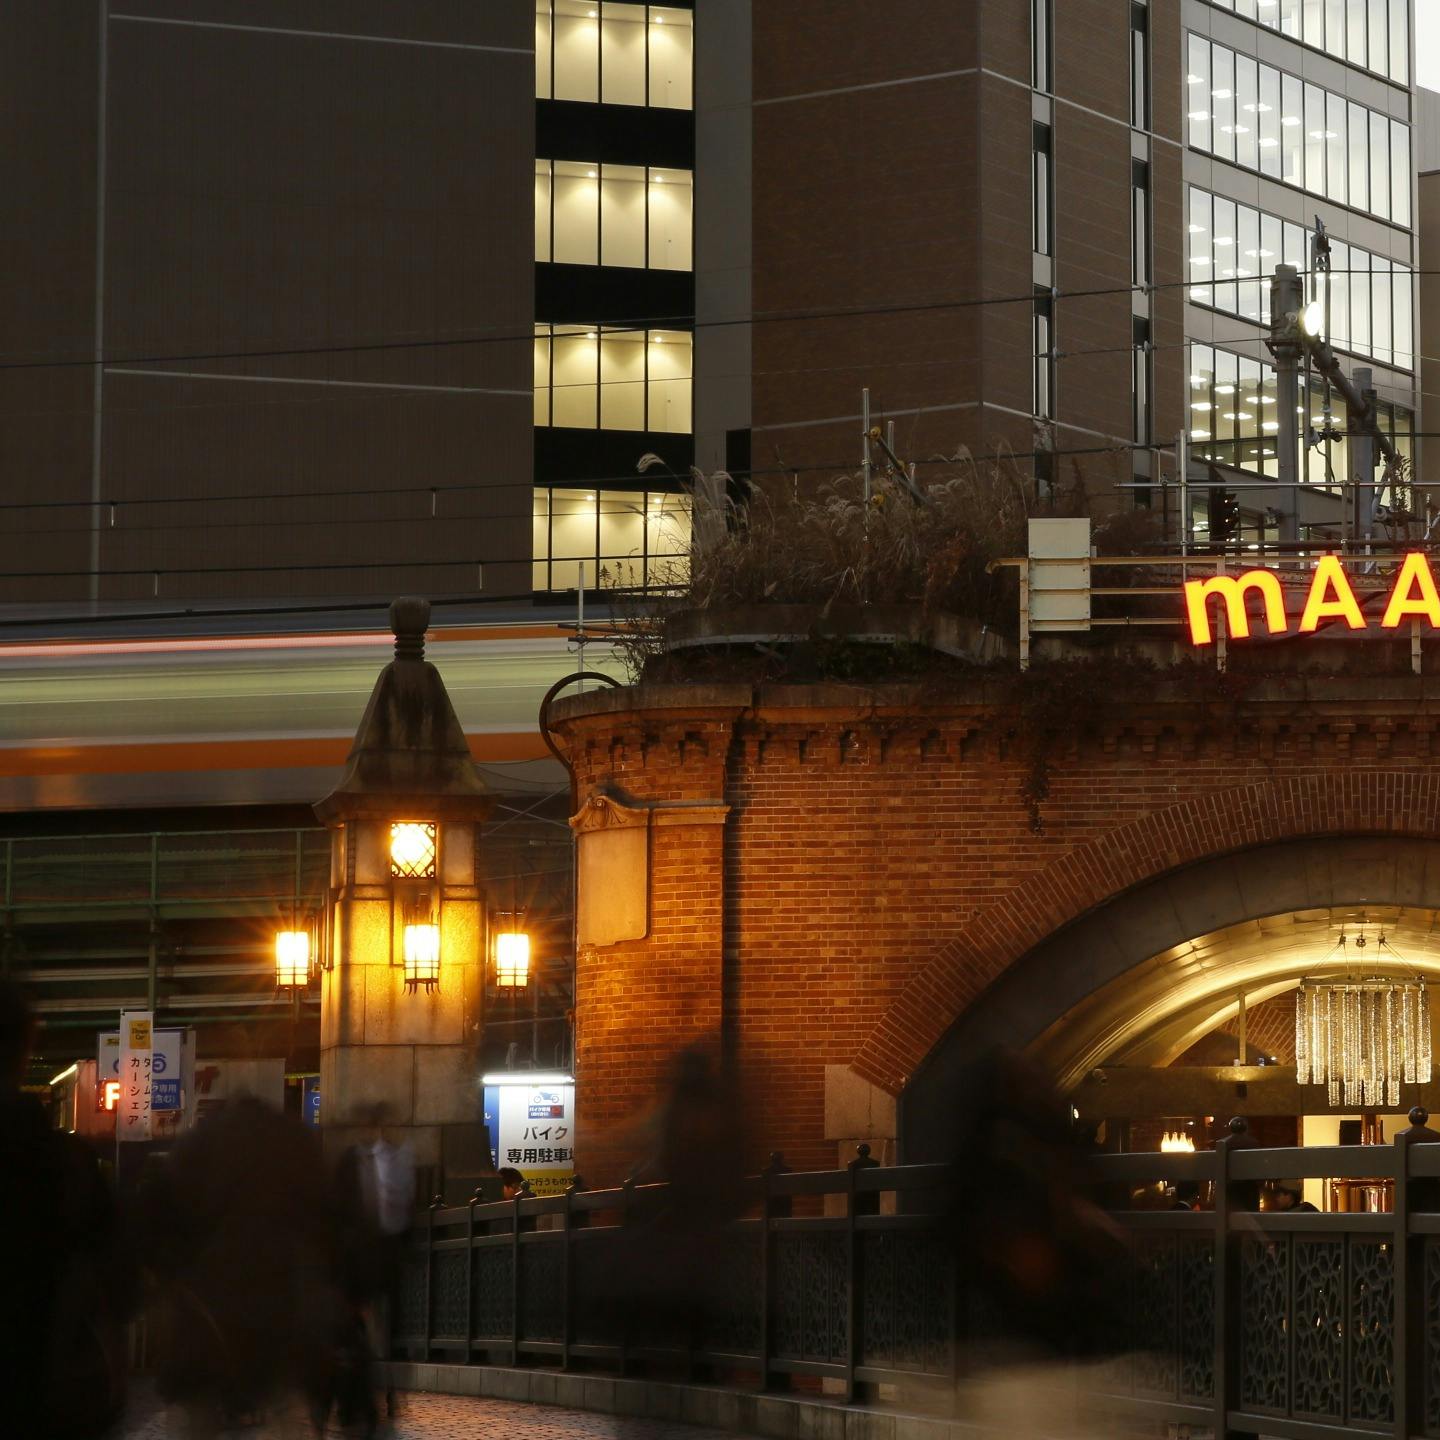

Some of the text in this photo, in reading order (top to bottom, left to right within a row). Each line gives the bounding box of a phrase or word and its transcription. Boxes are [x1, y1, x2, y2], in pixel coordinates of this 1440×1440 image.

[128, 1057, 141, 1126] カーシェア
[523, 1126, 568, 1140] バイク
